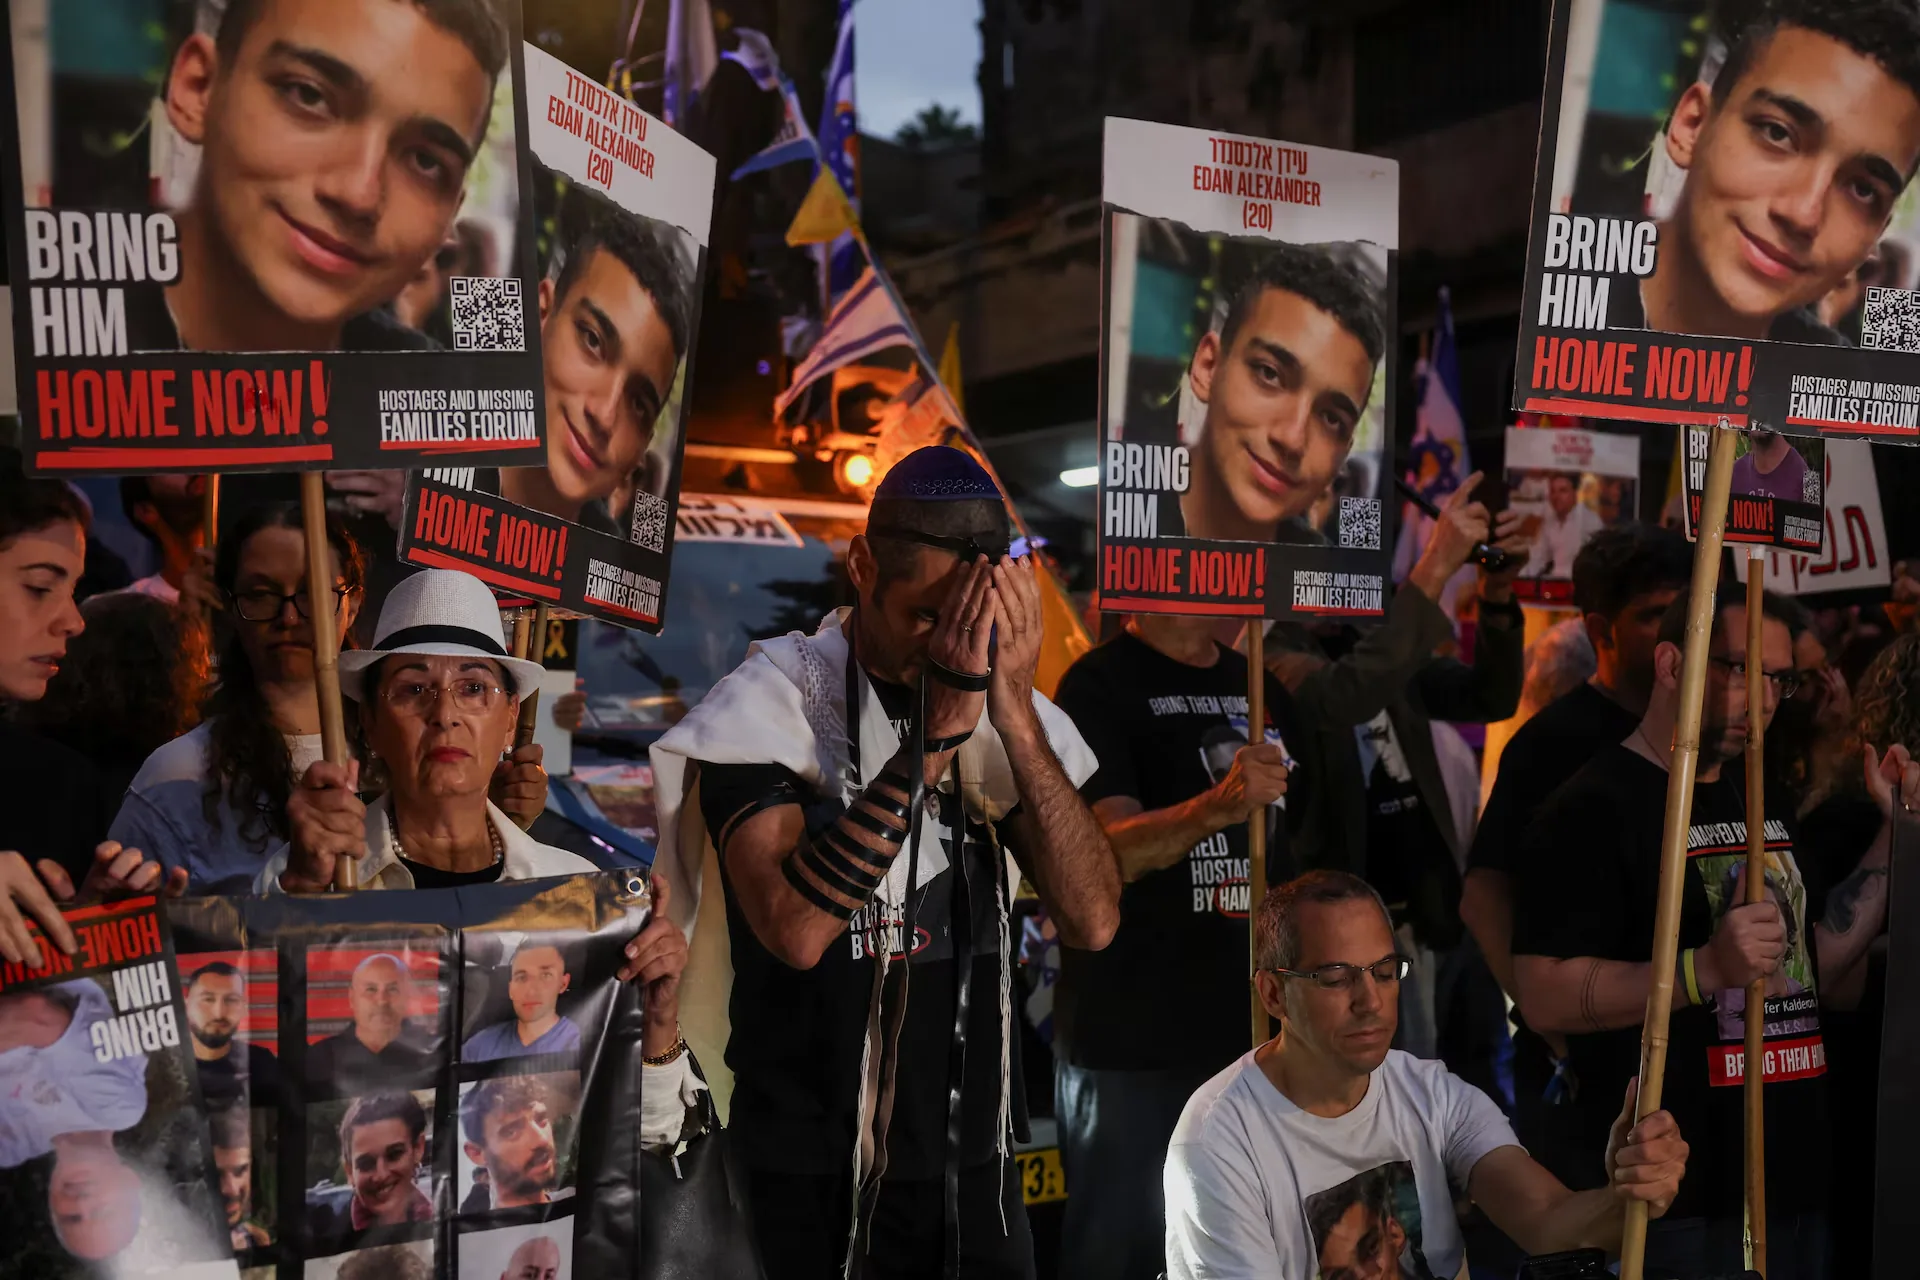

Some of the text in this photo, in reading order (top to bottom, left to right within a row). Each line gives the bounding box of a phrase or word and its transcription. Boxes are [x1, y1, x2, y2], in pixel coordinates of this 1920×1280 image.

[565, 71, 647, 142] עידן אלכסנדר
[547, 95, 655, 179] EDAN ALEXANDER
[1208, 137, 1308, 175] עידן אלכסנדר
[587, 149, 613, 190] (20)
[1193, 165, 1321, 206] EDAN ALEXANDER
[1242, 200, 1273, 232] (20)
[25, 210, 178, 282] BRING
[1543, 214, 1657, 275] BRING
[30, 287, 128, 357] HIM
[1538, 272, 1610, 331] HIM
[1531, 335, 1753, 406] HOME NOW!
[1791, 374, 1920, 403] HOSTAGES AND MISSING
[36, 360, 331, 439] HOME NOW!
[379, 389, 534, 411] HOSTAGES AND MISSING
[1788, 392, 1919, 429] FAMILIES FORUM
[380, 411, 536, 442] FAMILIES FORUM
[1106, 442, 1190, 492] BRING
[415, 488, 568, 581] HOME NOW!
[1105, 491, 1158, 539] HIM
[1733, 499, 1774, 532] NOW!
[588, 558, 661, 597] HOSTAGES AND MISSING
[1104, 545, 1265, 599] HOME NOW!
[1293, 570, 1383, 590] HOSTAGES AND MISSING
[585, 573, 660, 618] FAMILIES FORUM
[1293, 585, 1383, 611] FAMILIES FORUM
[1148, 695, 1189, 716] BRING
[1185, 695, 1222, 715] THEM
[1688, 822, 1736, 848] DNAPPED
[1191, 858, 1250, 886] HOSTAG
[1193, 885, 1250, 913] BY HAM
[76, 912, 162, 968] HOME
[112, 960, 172, 1012] HIM
[1764, 1002, 1780, 1014] fer
[90, 1004, 180, 1063] BRING
[1725, 1051, 1776, 1077] BRG
